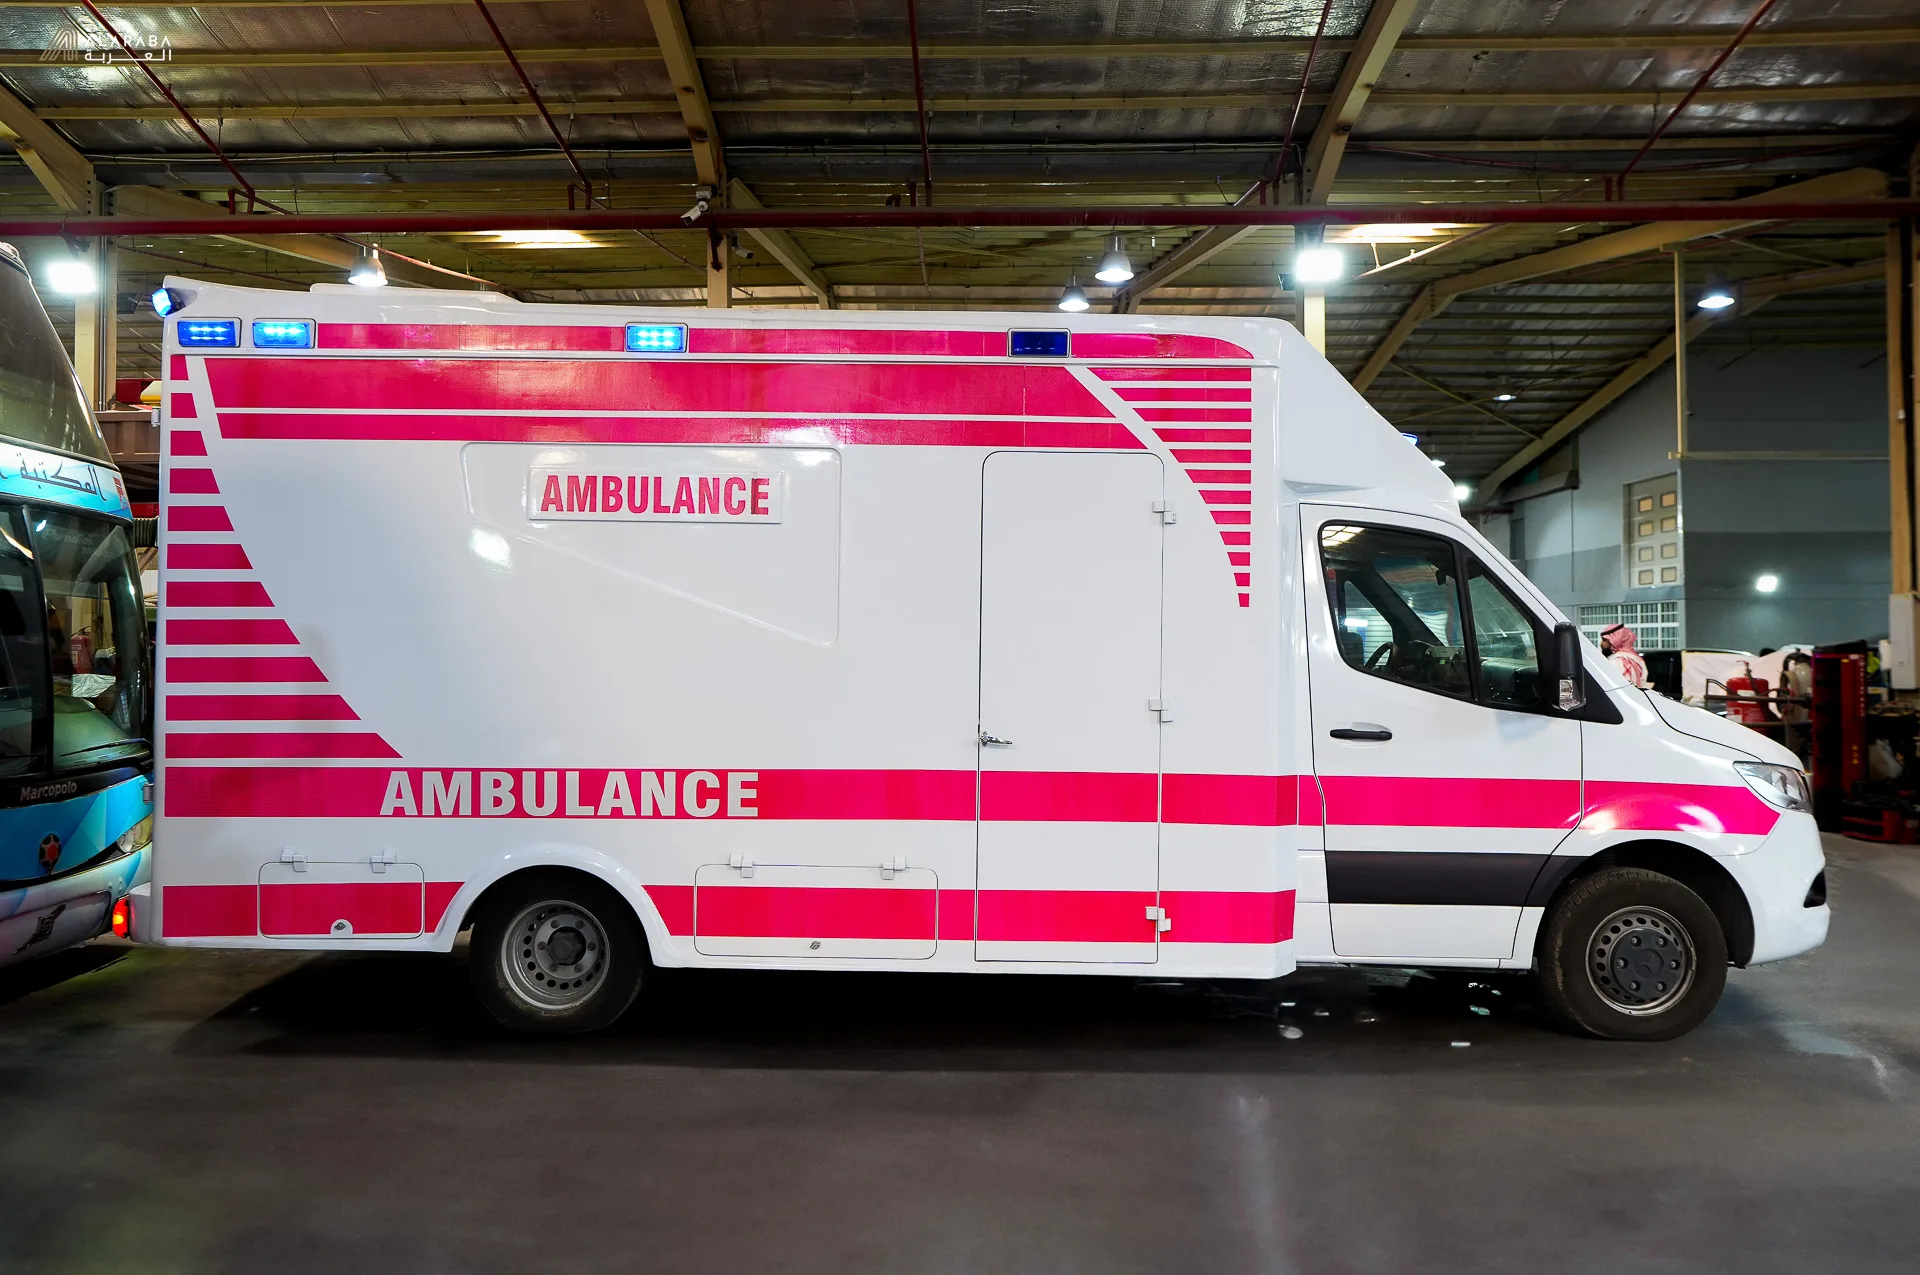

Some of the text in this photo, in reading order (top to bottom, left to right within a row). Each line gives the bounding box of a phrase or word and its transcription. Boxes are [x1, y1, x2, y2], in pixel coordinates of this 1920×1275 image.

[16, 452, 107, 501] المكتبة
[540, 474, 770, 516] AMBULANCE
[20, 781, 77, 801] Marcopolo
[379, 770, 759, 818] AMBULANCE
